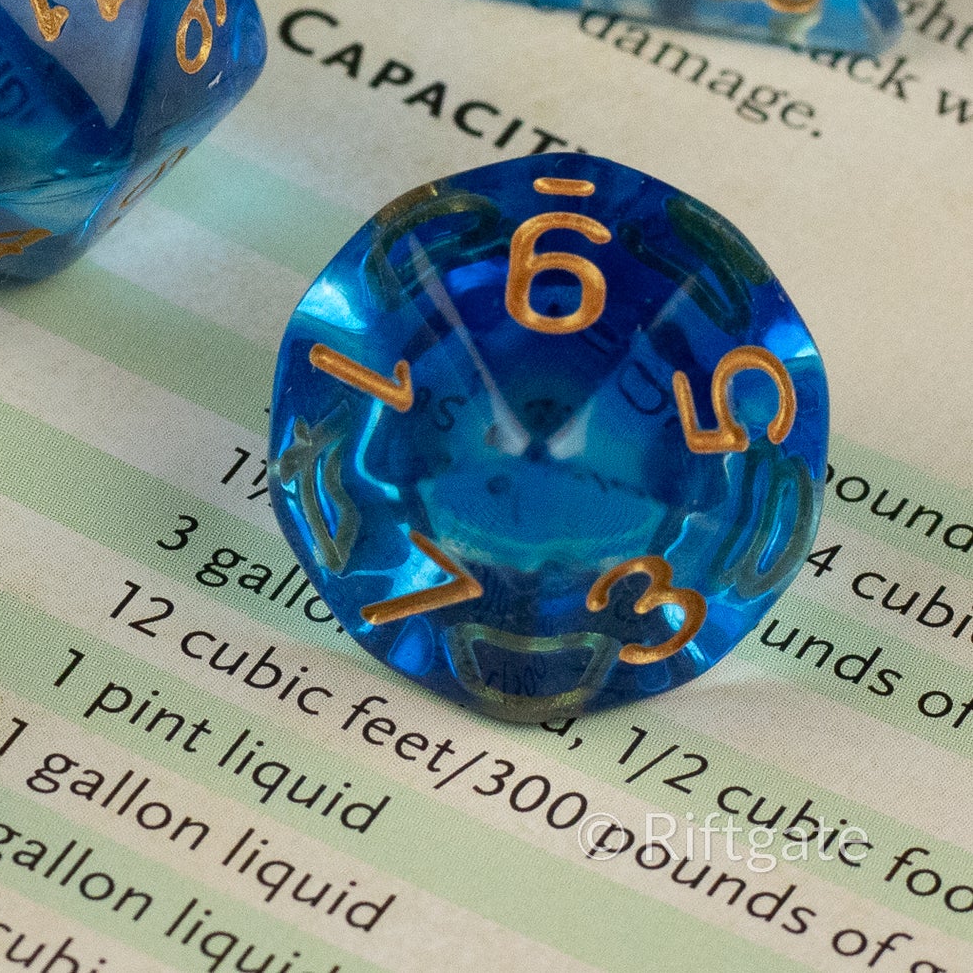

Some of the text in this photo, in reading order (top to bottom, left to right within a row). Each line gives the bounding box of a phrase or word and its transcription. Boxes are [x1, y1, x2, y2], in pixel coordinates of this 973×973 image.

[277, 7, 589, 156] CAPACIT
[577, 12, 825, 139] damage.
[672, 344, 797, 454] 5
[585, 554, 708, 665] 3
[54, 648, 85, 688] 1
[83, 681, 212, 754] pint
[217, 729, 391, 834] liquid
[156, 514, 199, 551] 3
[617, 725, 709, 794] 1/2
[717, 785, 875, 868] cubic
[26, 752, 210, 851] gallon
[221, 828, 397, 932] liquid
[109, 580, 175, 638] 12
[180, 630, 333, 716] cubic
[340, 695, 589, 830] feet/300
[588, 822, 817, 936] pounds
[831, 927, 913, 970] of
[164, 898, 341, 973] liqui
